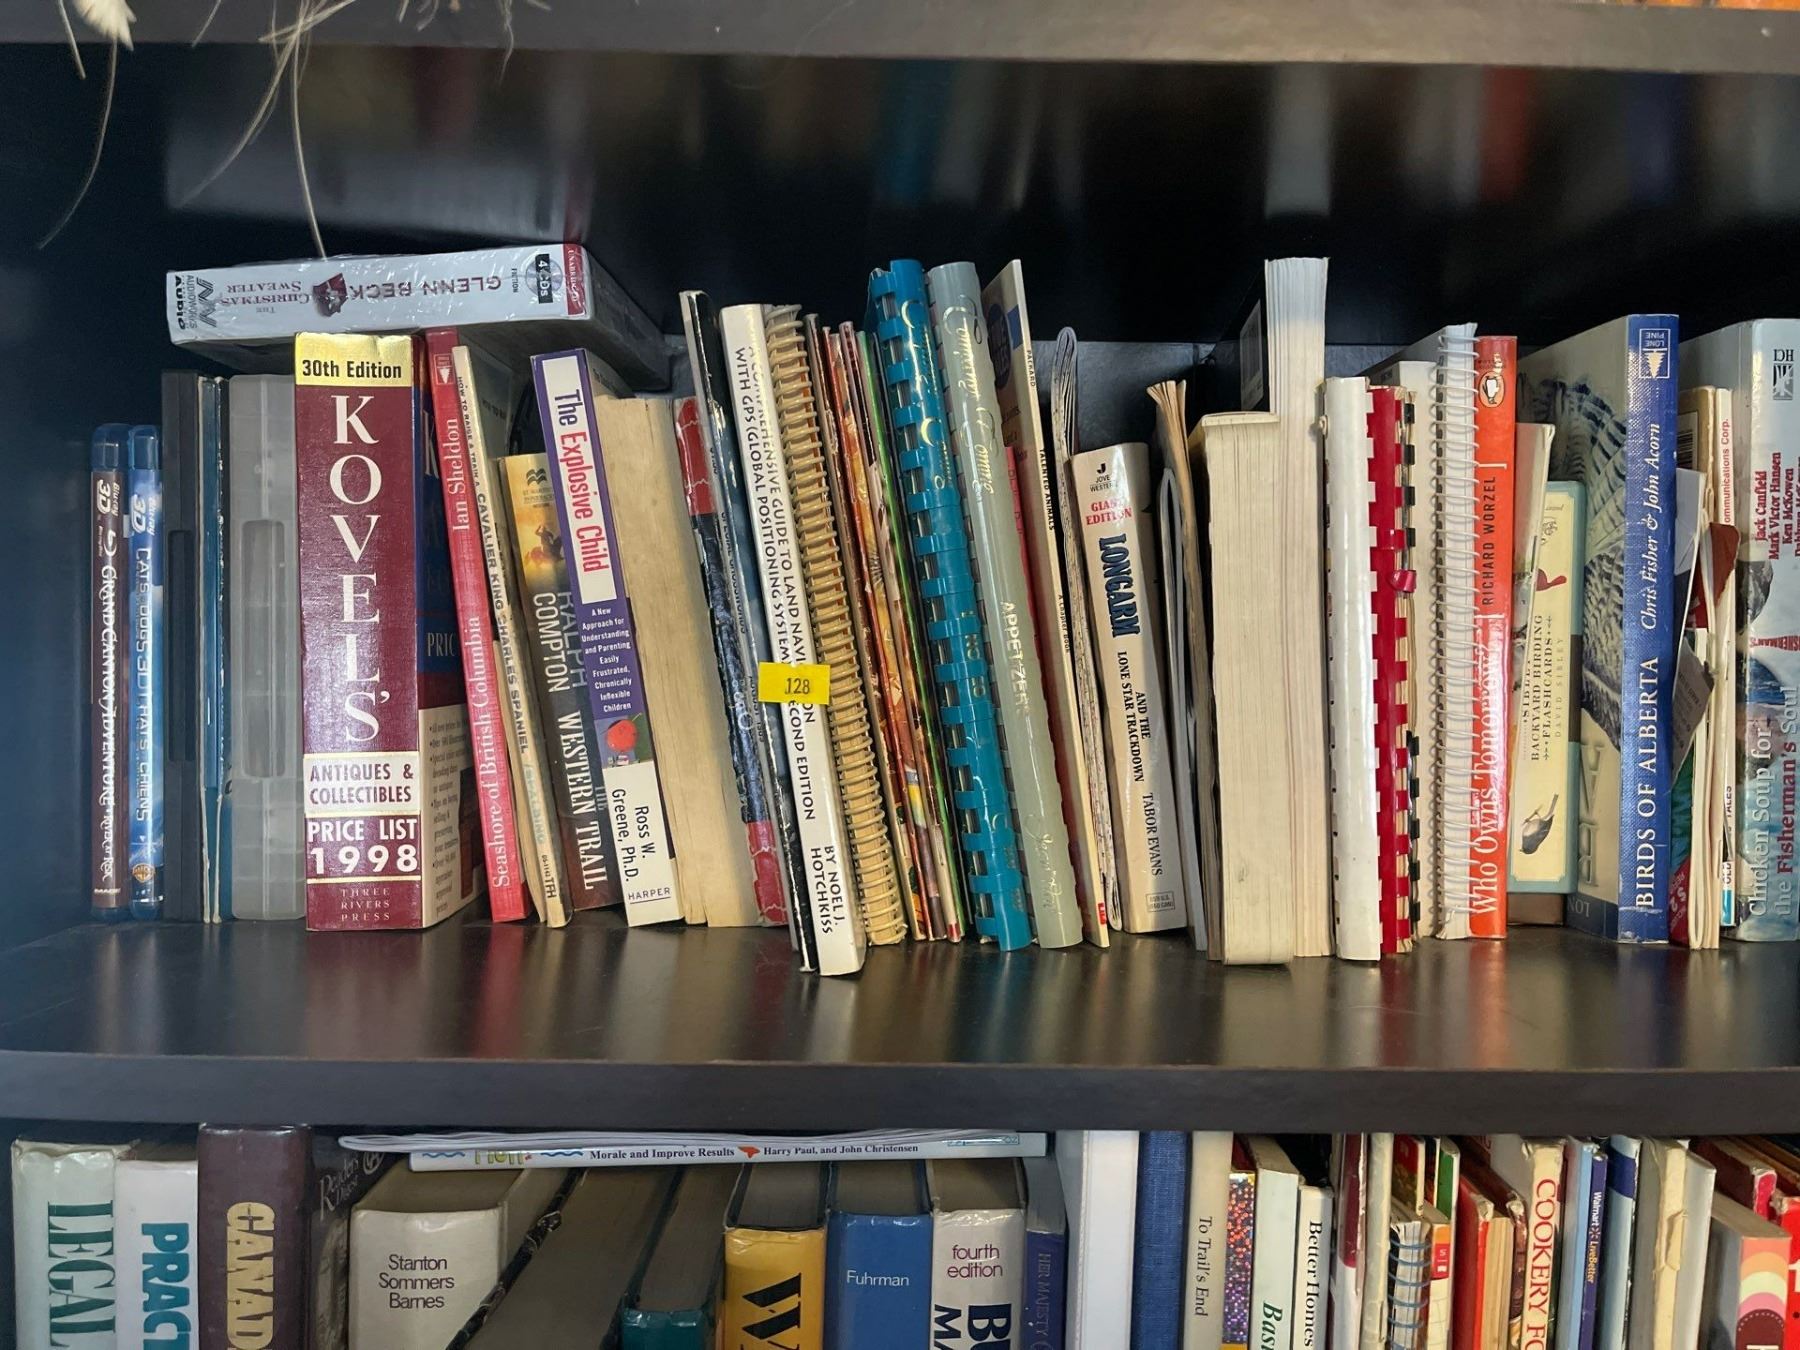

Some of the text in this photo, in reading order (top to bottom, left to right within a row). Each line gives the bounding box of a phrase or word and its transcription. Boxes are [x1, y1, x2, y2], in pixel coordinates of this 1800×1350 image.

[175, 275, 186, 330] AUDIO
[219, 293, 310, 305] CHRISTMAS
[227, 281, 302, 293] SWEATER
[350, 276, 501, 299] GLENN BECK
[302, 360, 402, 378] 30th Edition
[1026, 349, 1035, 387] PACKARD
[1773, 349, 1794, 361] HCI
[461, 400, 468, 411] TO
[97, 479, 110, 513] 3D
[441, 418, 469, 531] Ian Sheldon
[554, 389, 610, 573] The Explosive Child
[1039, 447, 1053, 531] TALENTED ANIMALS
[1096, 475, 1110, 483] JOVE
[131, 493, 144, 533] 3D
[1639, 423, 1663, 629] Chris Fisher & John Acorn
[1754, 471, 1766, 541] Jack Canfield
[1767, 452, 1781, 560] Mark Victor Hansen
[1782, 468, 1792, 544] Ken McKowen
[771, 498, 798, 618] GUIDE TO LAND
[1481, 476, 1496, 605] RICHARD WORZEL
[99, 565, 116, 624] GRAND
[733, 346, 816, 821] WITH GPS (GLOBAL POSITIONING EDITION
[1098, 532, 1139, 639] LONGARM
[477, 492, 528, 753] CAVALIER KING CHARLES SPANIEL
[581, 630, 630, 642] Understanding
[582, 619, 614, 631] Approach
[597, 608, 611, 616] New
[100, 625, 116, 701] CANYON
[532, 590, 571, 693] COMPTON
[585, 642, 631, 654] and Parenting
[599, 655, 619, 664] Easily
[594, 678, 632, 689] Chronically
[600, 690, 630, 700] Inflexible
[603, 702, 632, 712] Children
[784, 678, 810, 694] 128
[1531, 614, 1542, 761] BACKYARD BIRDING
[1542, 637, 1554, 738] FLASHCARDS
[1117, 650, 1145, 782] LONE STAR TRACKDOWN
[1135, 689, 1151, 739] AND THE
[98, 700, 115, 806] ADVENTURE
[310, 763, 414, 782] ANTIQUES &
[466, 616, 509, 887] Seashore of British Columbia
[309, 785, 412, 805] COLLECTIBLES
[557, 709, 607, 889] WESTERN TRAIL
[1635, 655, 1659, 906] BIRDS OF ALBERTA
[1774, 685, 1797, 915] the Fisherman's Soul
[308, 819, 417, 842] PRICE LIST
[612, 788, 639, 882] Greene, Ph.D.
[635, 806, 656, 859] Ross W.
[1140, 792, 1156, 833] TABOR
[1148, 836, 1163, 875] EVANS
[1749, 726, 1774, 916] Chicken Soup for
[310, 844, 418, 875] 1998
[1471, 788, 1499, 913] Who Owns
[341, 888, 390, 898] THREE
[341, 900, 390, 910] RIVERS
[544, 876, 556, 899] TFH
[628, 887, 671, 900] HARPER
[808, 846, 834, 934] HOTCHKISS
[824, 845, 845, 926] BY NOEL J.
[341, 913, 390, 922] PRESS
[590, 1143, 918, 1159] Morale and Improve Results Harry Paul, and John Christensen
[1591, 1191, 1602, 1226] Walmart
[388, 1254, 447, 1271] Stanton
[947, 1261, 1003, 1279] edition
[952, 1243, 1000, 1260] fourth
[1194, 1216, 1212, 1316] To Trail's End
[1528, 1179, 1556, 1315] COOKERY
[48, 1200, 116, 1349] LEGAL
[378, 1272, 455, 1290] Sommers
[847, 1270, 909, 1287] Fuhrman
[1035, 1252, 1050, 1336] HER MAJESTY
[1303, 1221, 1322, 1347] Better Homes
[389, 1292, 445, 1309] Barnes
